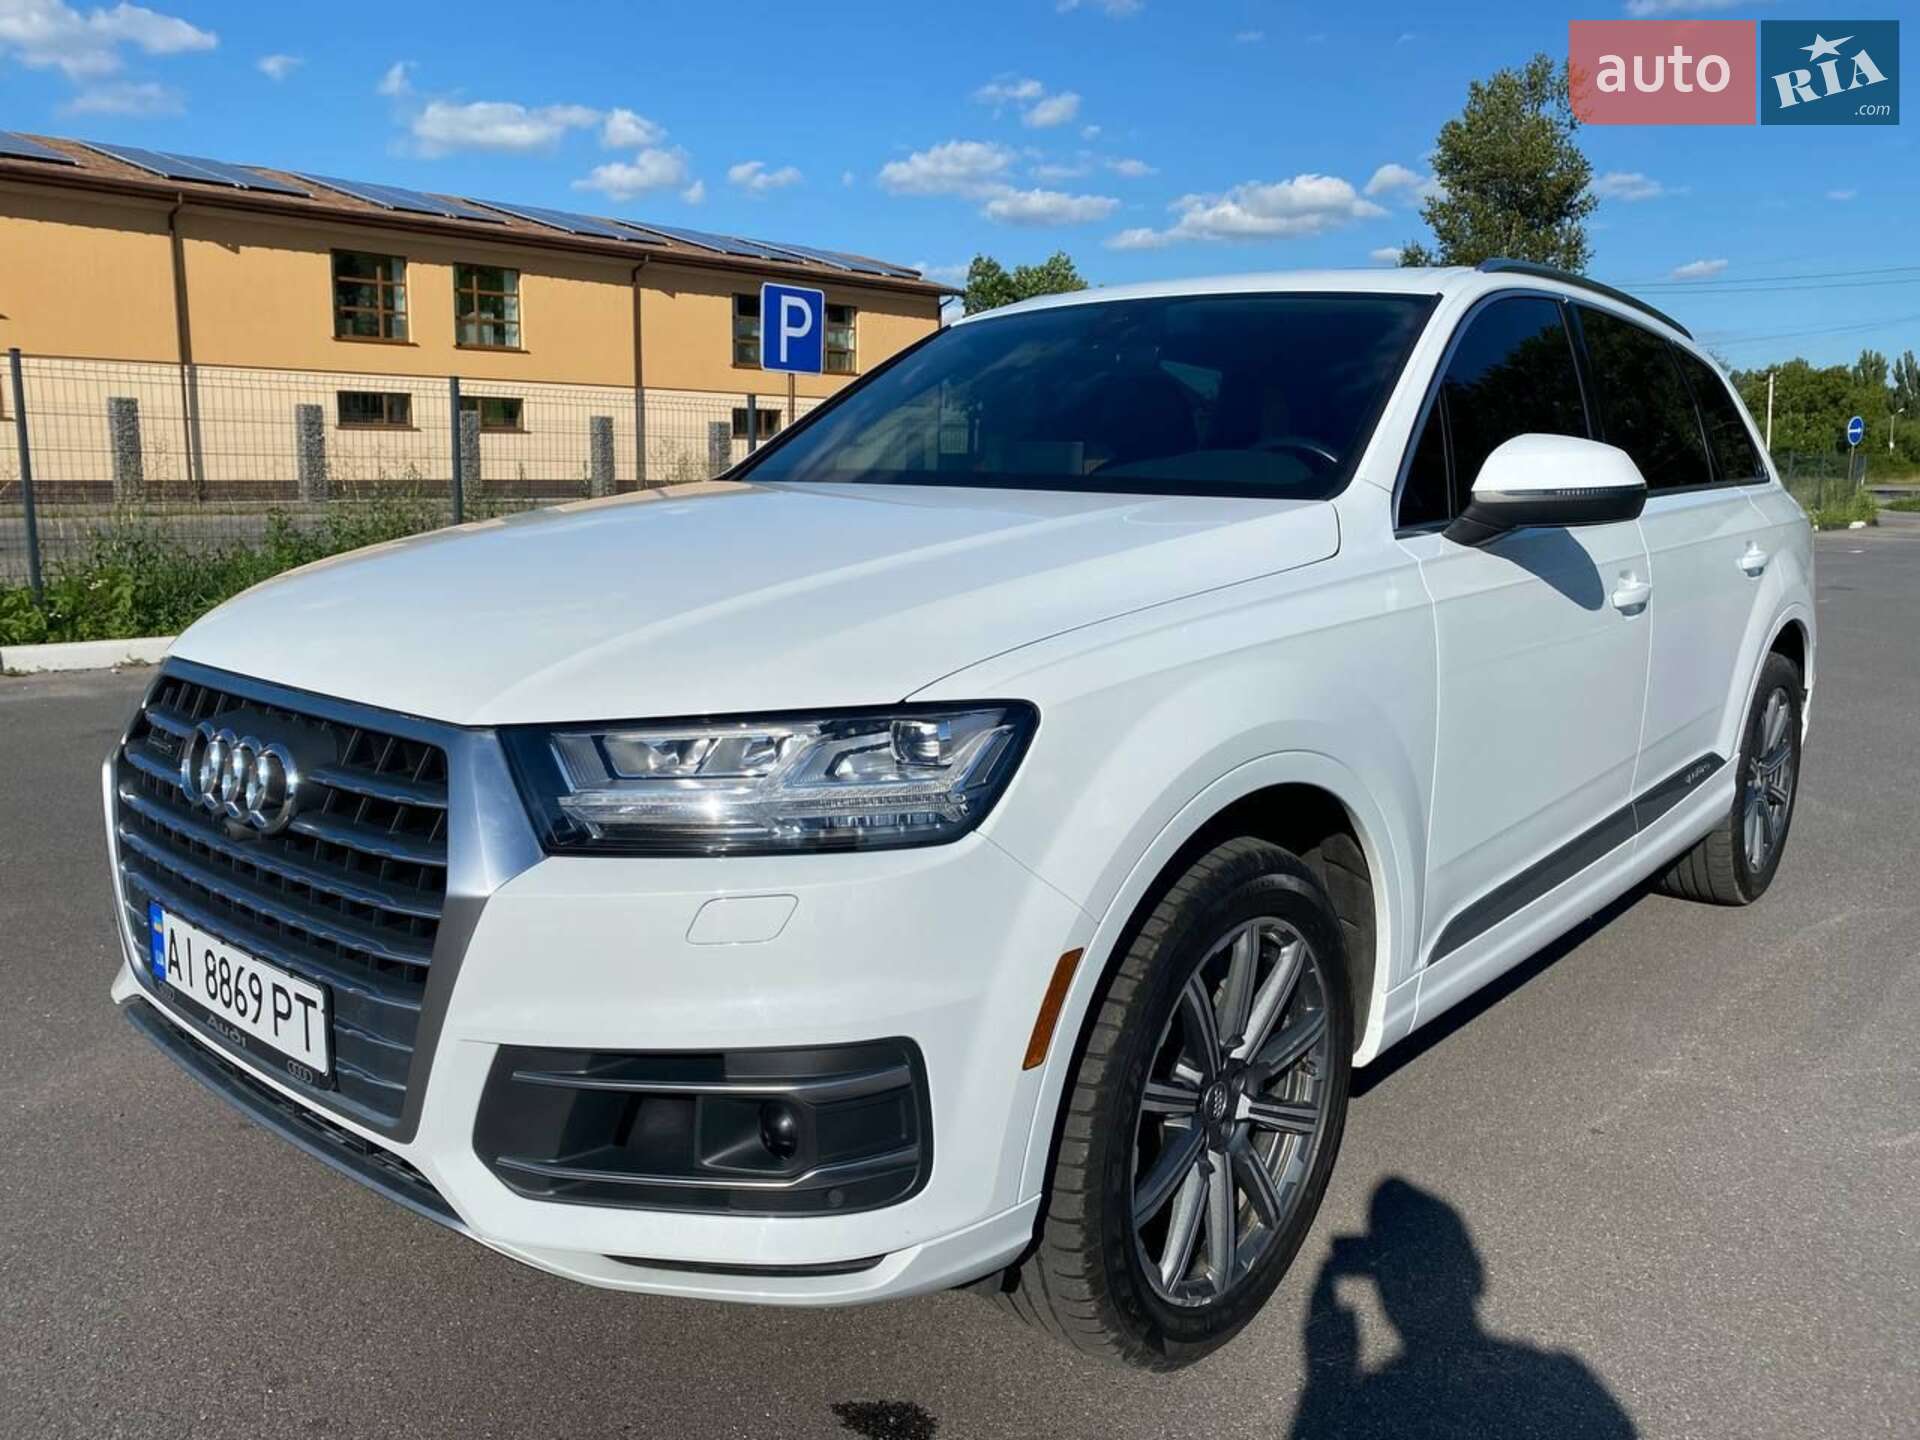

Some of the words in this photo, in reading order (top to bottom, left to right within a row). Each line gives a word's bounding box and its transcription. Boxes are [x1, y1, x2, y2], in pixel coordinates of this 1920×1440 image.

[780, 294, 813, 363] P
[168, 927, 193, 988] AI
[204, 949, 263, 1024] 8869
[272, 982, 317, 1053] PT
